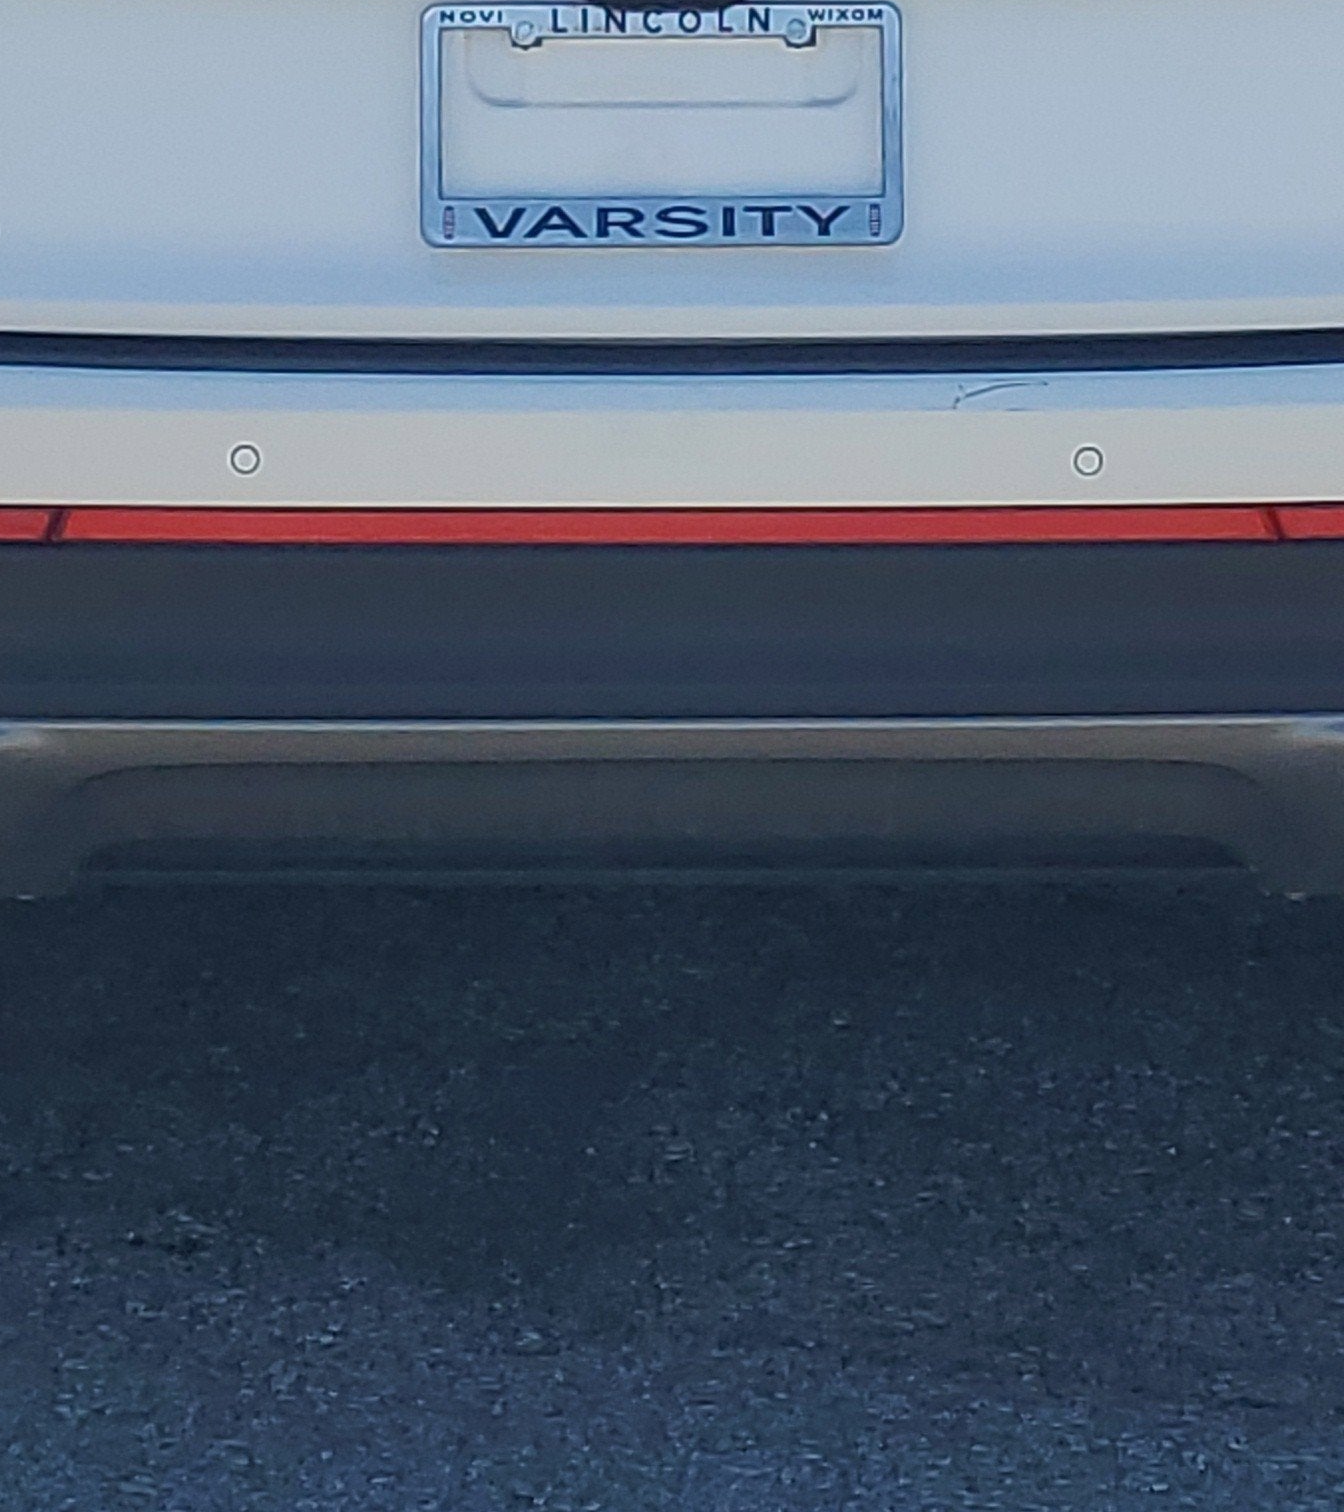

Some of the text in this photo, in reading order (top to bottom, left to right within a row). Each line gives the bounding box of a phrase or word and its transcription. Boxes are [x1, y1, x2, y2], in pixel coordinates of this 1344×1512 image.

[439, 7, 884, 33] NOVI LINCOLN WIXOM
[474, 204, 851, 239] VARSITY
